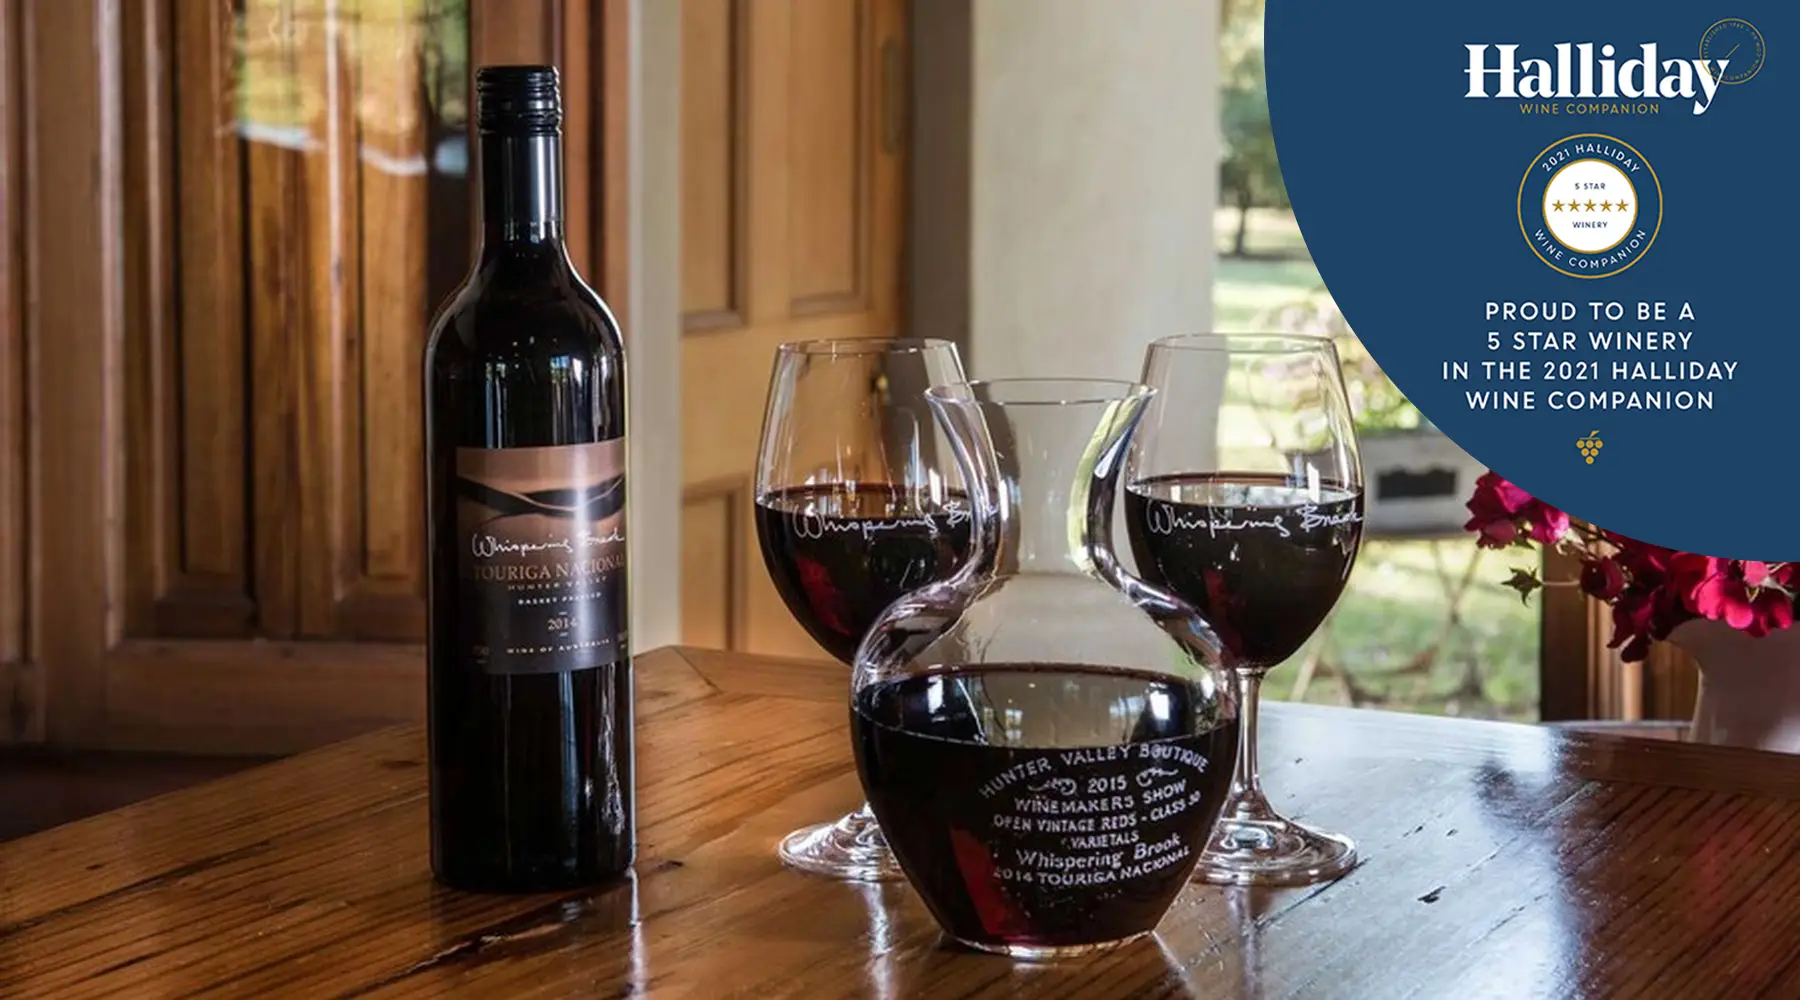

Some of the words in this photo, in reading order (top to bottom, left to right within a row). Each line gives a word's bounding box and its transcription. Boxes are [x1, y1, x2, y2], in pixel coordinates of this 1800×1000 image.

[473, 564, 552, 582] TOURIGA
[979, 756, 1052, 800] HUNTER
[1060, 744, 1132, 768] VALLEY
[1138, 743, 1210, 774] BOUTIQUE
[1087, 776, 1128, 794] 2015
[1142, 778, 1187, 805] SHOW
[993, 814, 1032, 832] OPEN
[1036, 818, 1095, 833] VINTAGE
[1101, 811, 1137, 831] REDS
[1070, 829, 1140, 849] VARIETALS
[1015, 849, 1124, 872] Whispering
[1133, 832, 1181, 860] Brook
[992, 866, 1034, 883] 2014
[1038, 870, 1117, 886] TOURIGA
